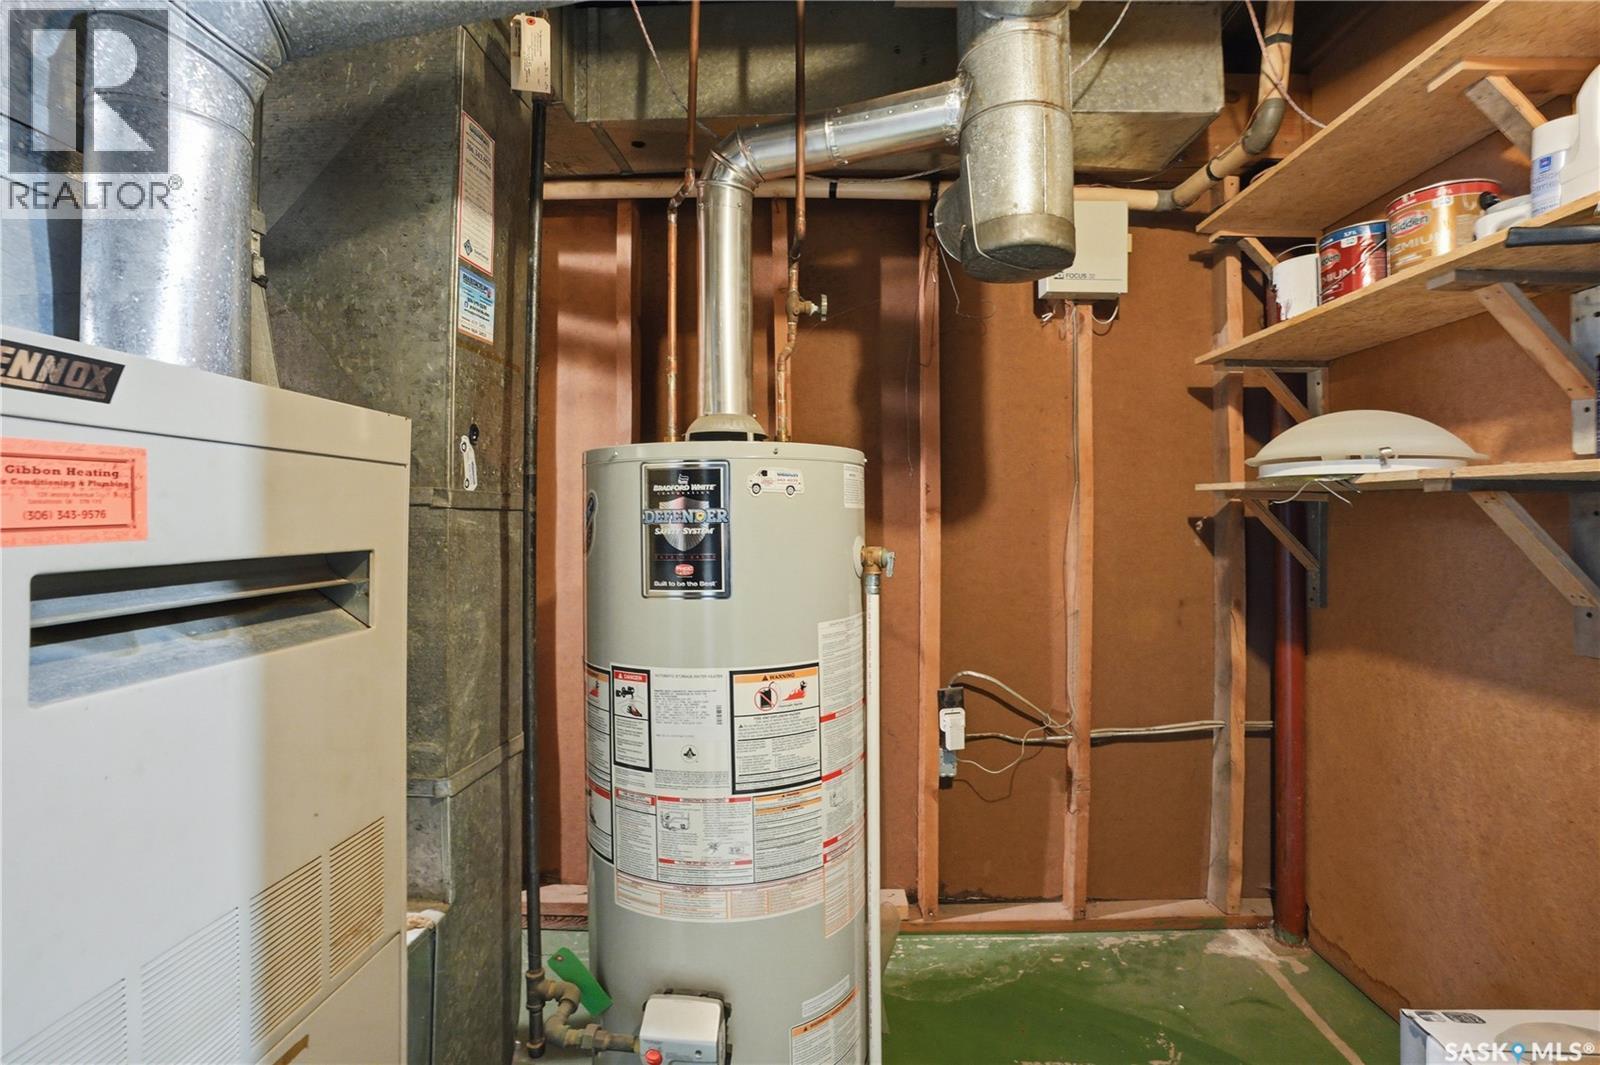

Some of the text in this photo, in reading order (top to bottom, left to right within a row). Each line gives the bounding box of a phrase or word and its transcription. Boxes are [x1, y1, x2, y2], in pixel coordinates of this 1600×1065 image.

[4, 465, 119, 480] Gibbon Heating
[11, 478, 75, 488] Conditioning
[87, 480, 129, 489] Plumbing
[653, 484, 690, 492] BRADFORD
[23, 509, 107, 520] (306) 343-9576
[644, 508, 729, 524] DEFENDER
